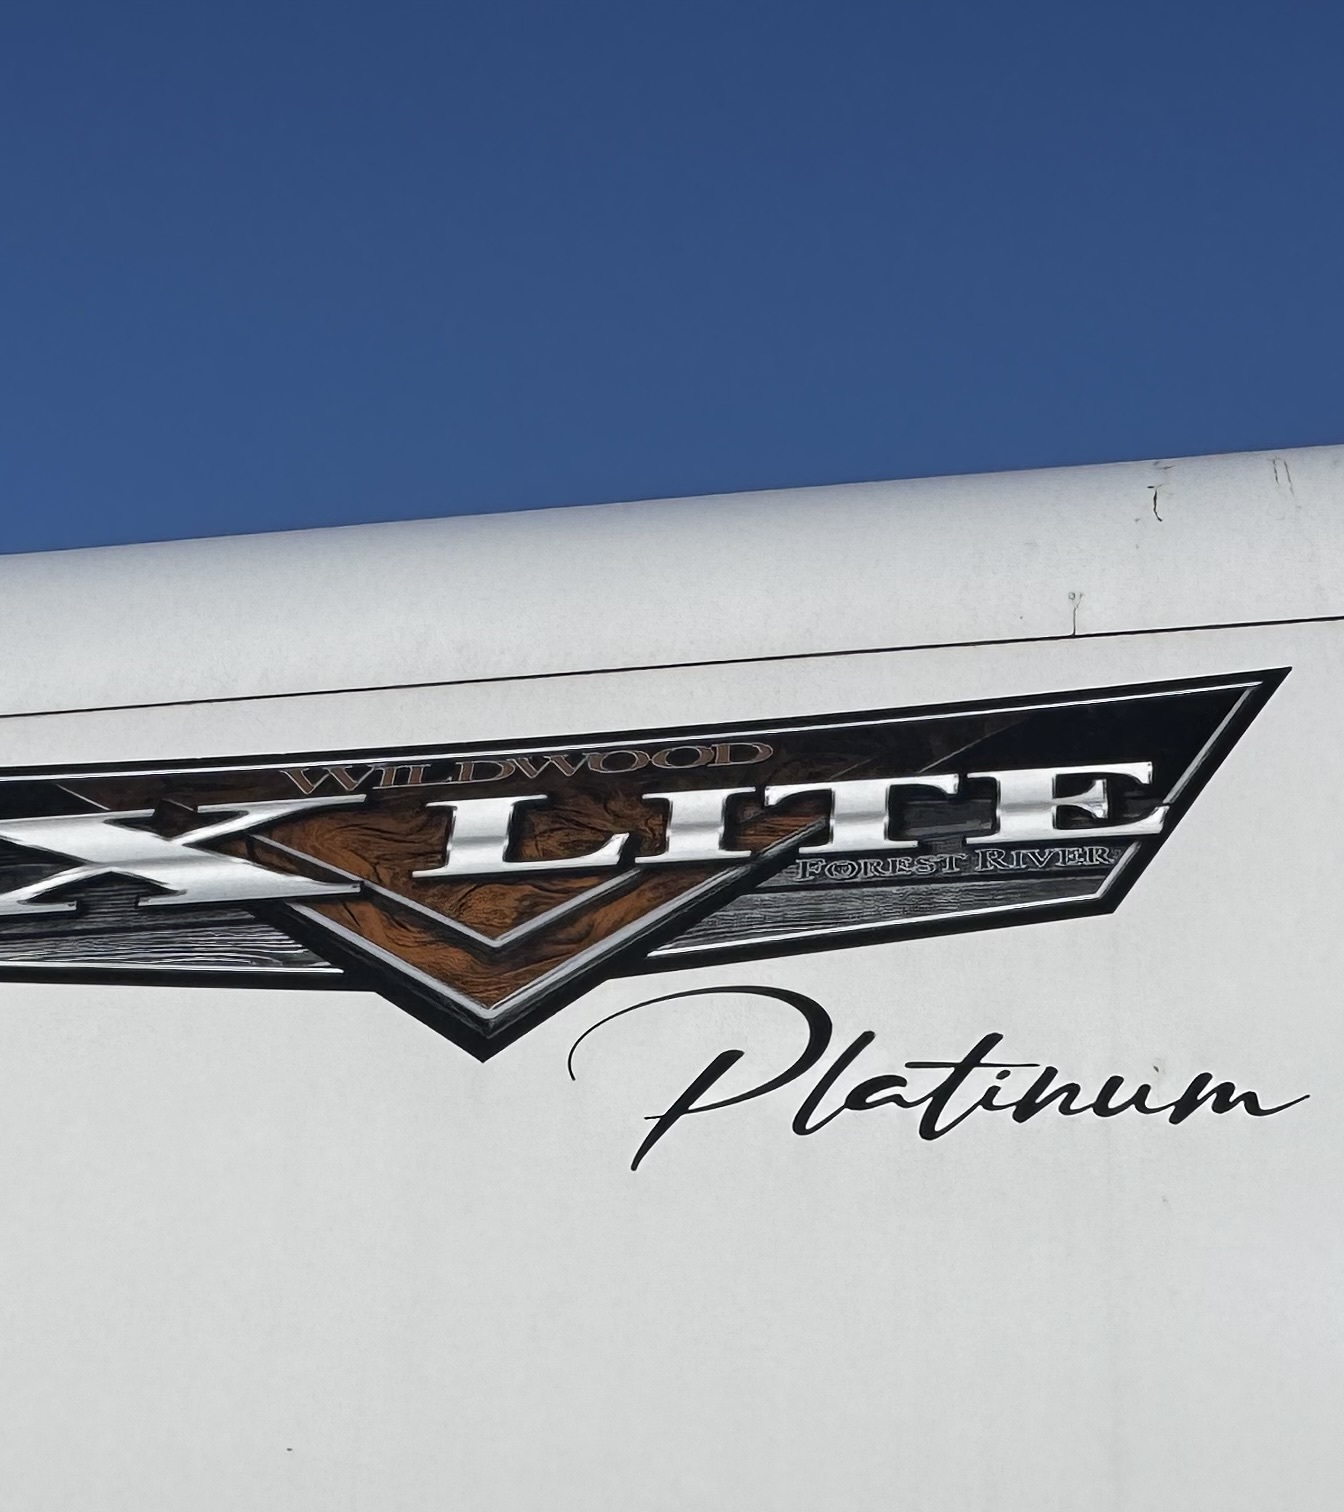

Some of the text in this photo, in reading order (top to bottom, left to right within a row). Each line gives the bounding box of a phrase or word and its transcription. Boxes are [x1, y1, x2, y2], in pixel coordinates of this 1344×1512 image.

[280, 742, 773, 795] WILDWOOD
[794, 845, 1115, 883] FOREST RIVER
[568, 985, 1311, 1171] Platinum
